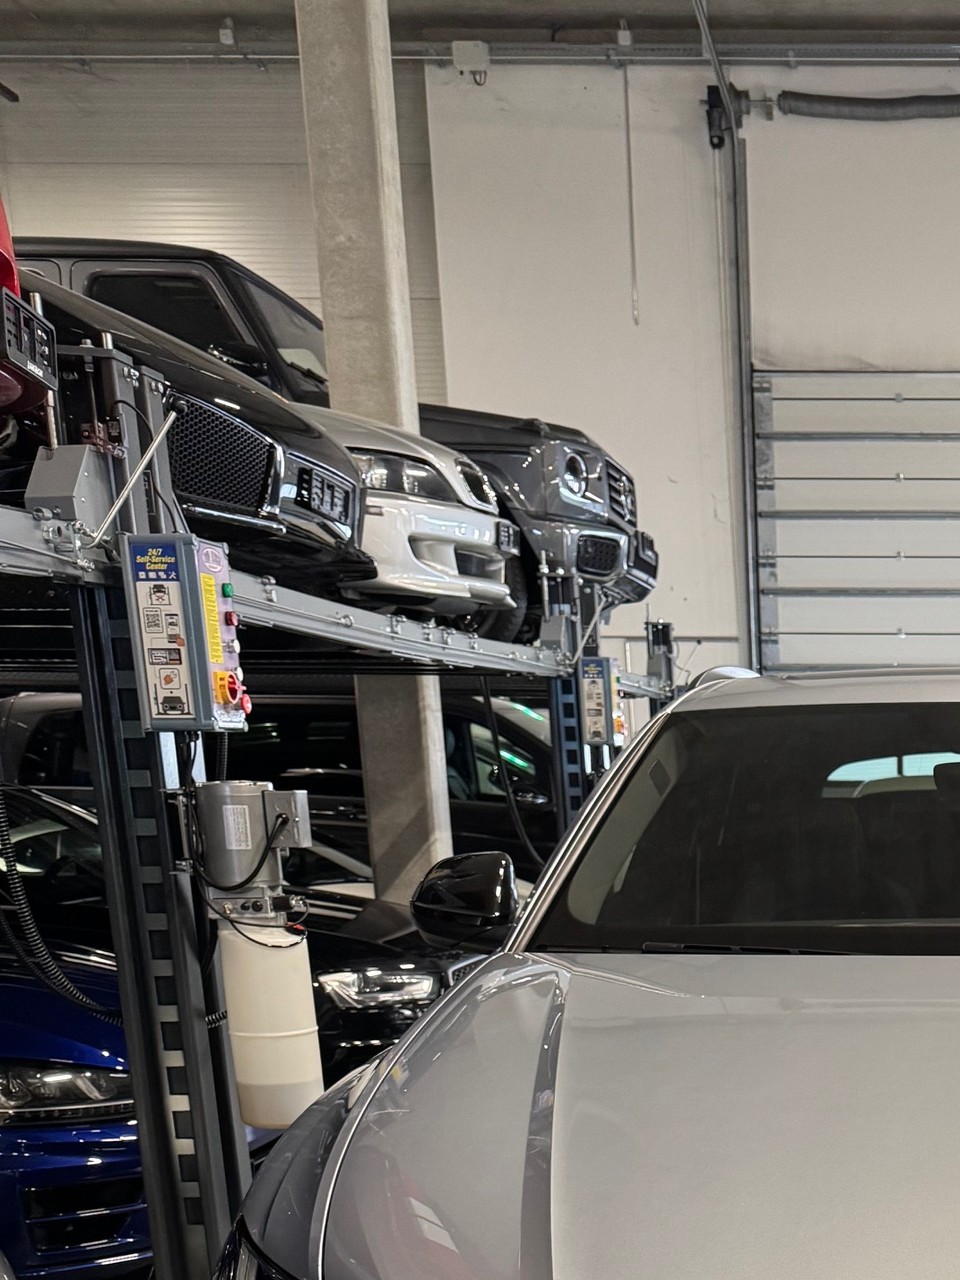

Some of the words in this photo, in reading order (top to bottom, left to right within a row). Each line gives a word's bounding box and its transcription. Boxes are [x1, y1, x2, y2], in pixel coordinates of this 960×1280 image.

[147, 548, 163, 556] 24/7
[136, 555, 176, 564] Self-Service
[146, 562, 168, 570] Center
